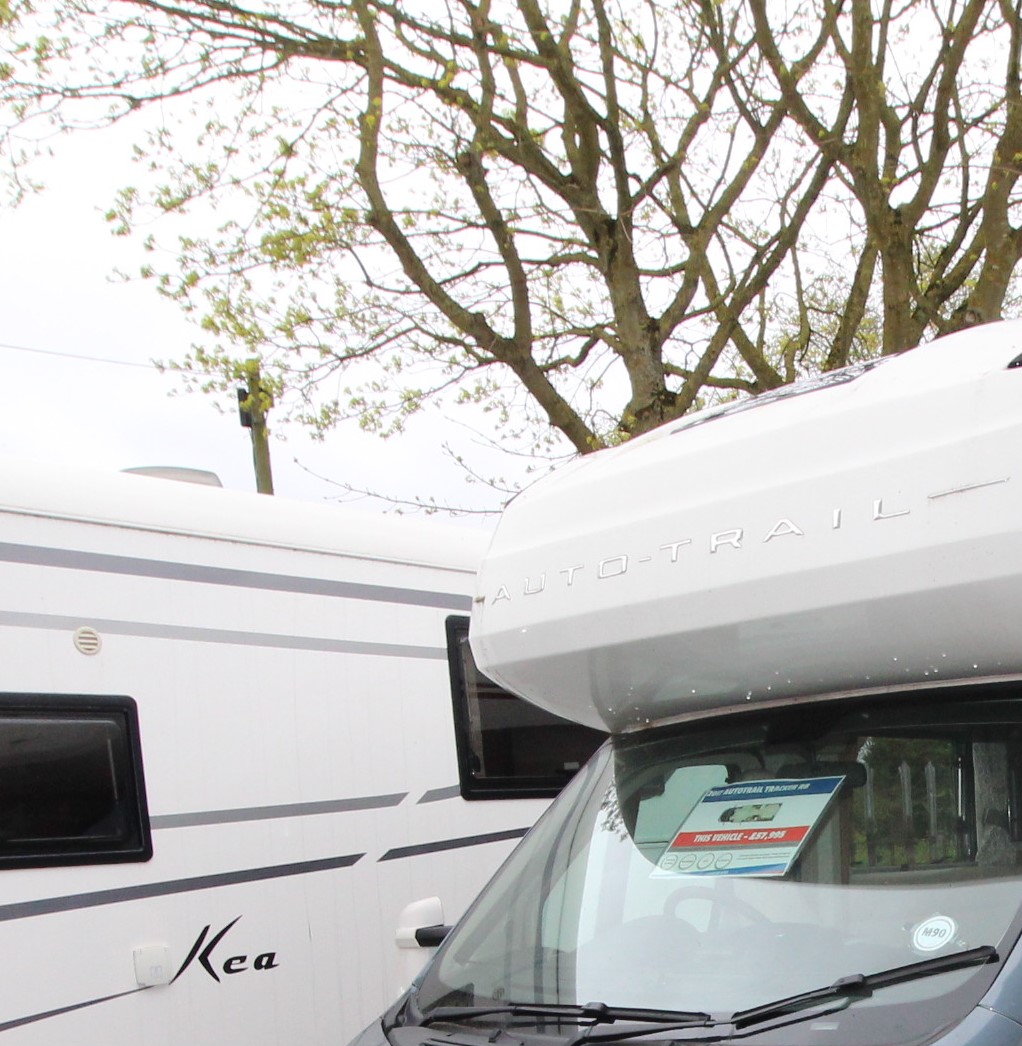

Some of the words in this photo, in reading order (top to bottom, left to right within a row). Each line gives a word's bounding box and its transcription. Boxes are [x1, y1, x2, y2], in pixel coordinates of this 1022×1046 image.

[491, 498, 911, 605] AUTO-TRAIL
[723, 785, 763, 795] AUTOTRAIL
[763, 783, 798, 793] TRACKER
[694, 833, 711, 842] THIS
[711, 832, 743, 842] VEHICLE
[748, 830, 787, 841] £57,995
[921, 927, 947, 938] M90
[168, 914, 280, 986] Kea
